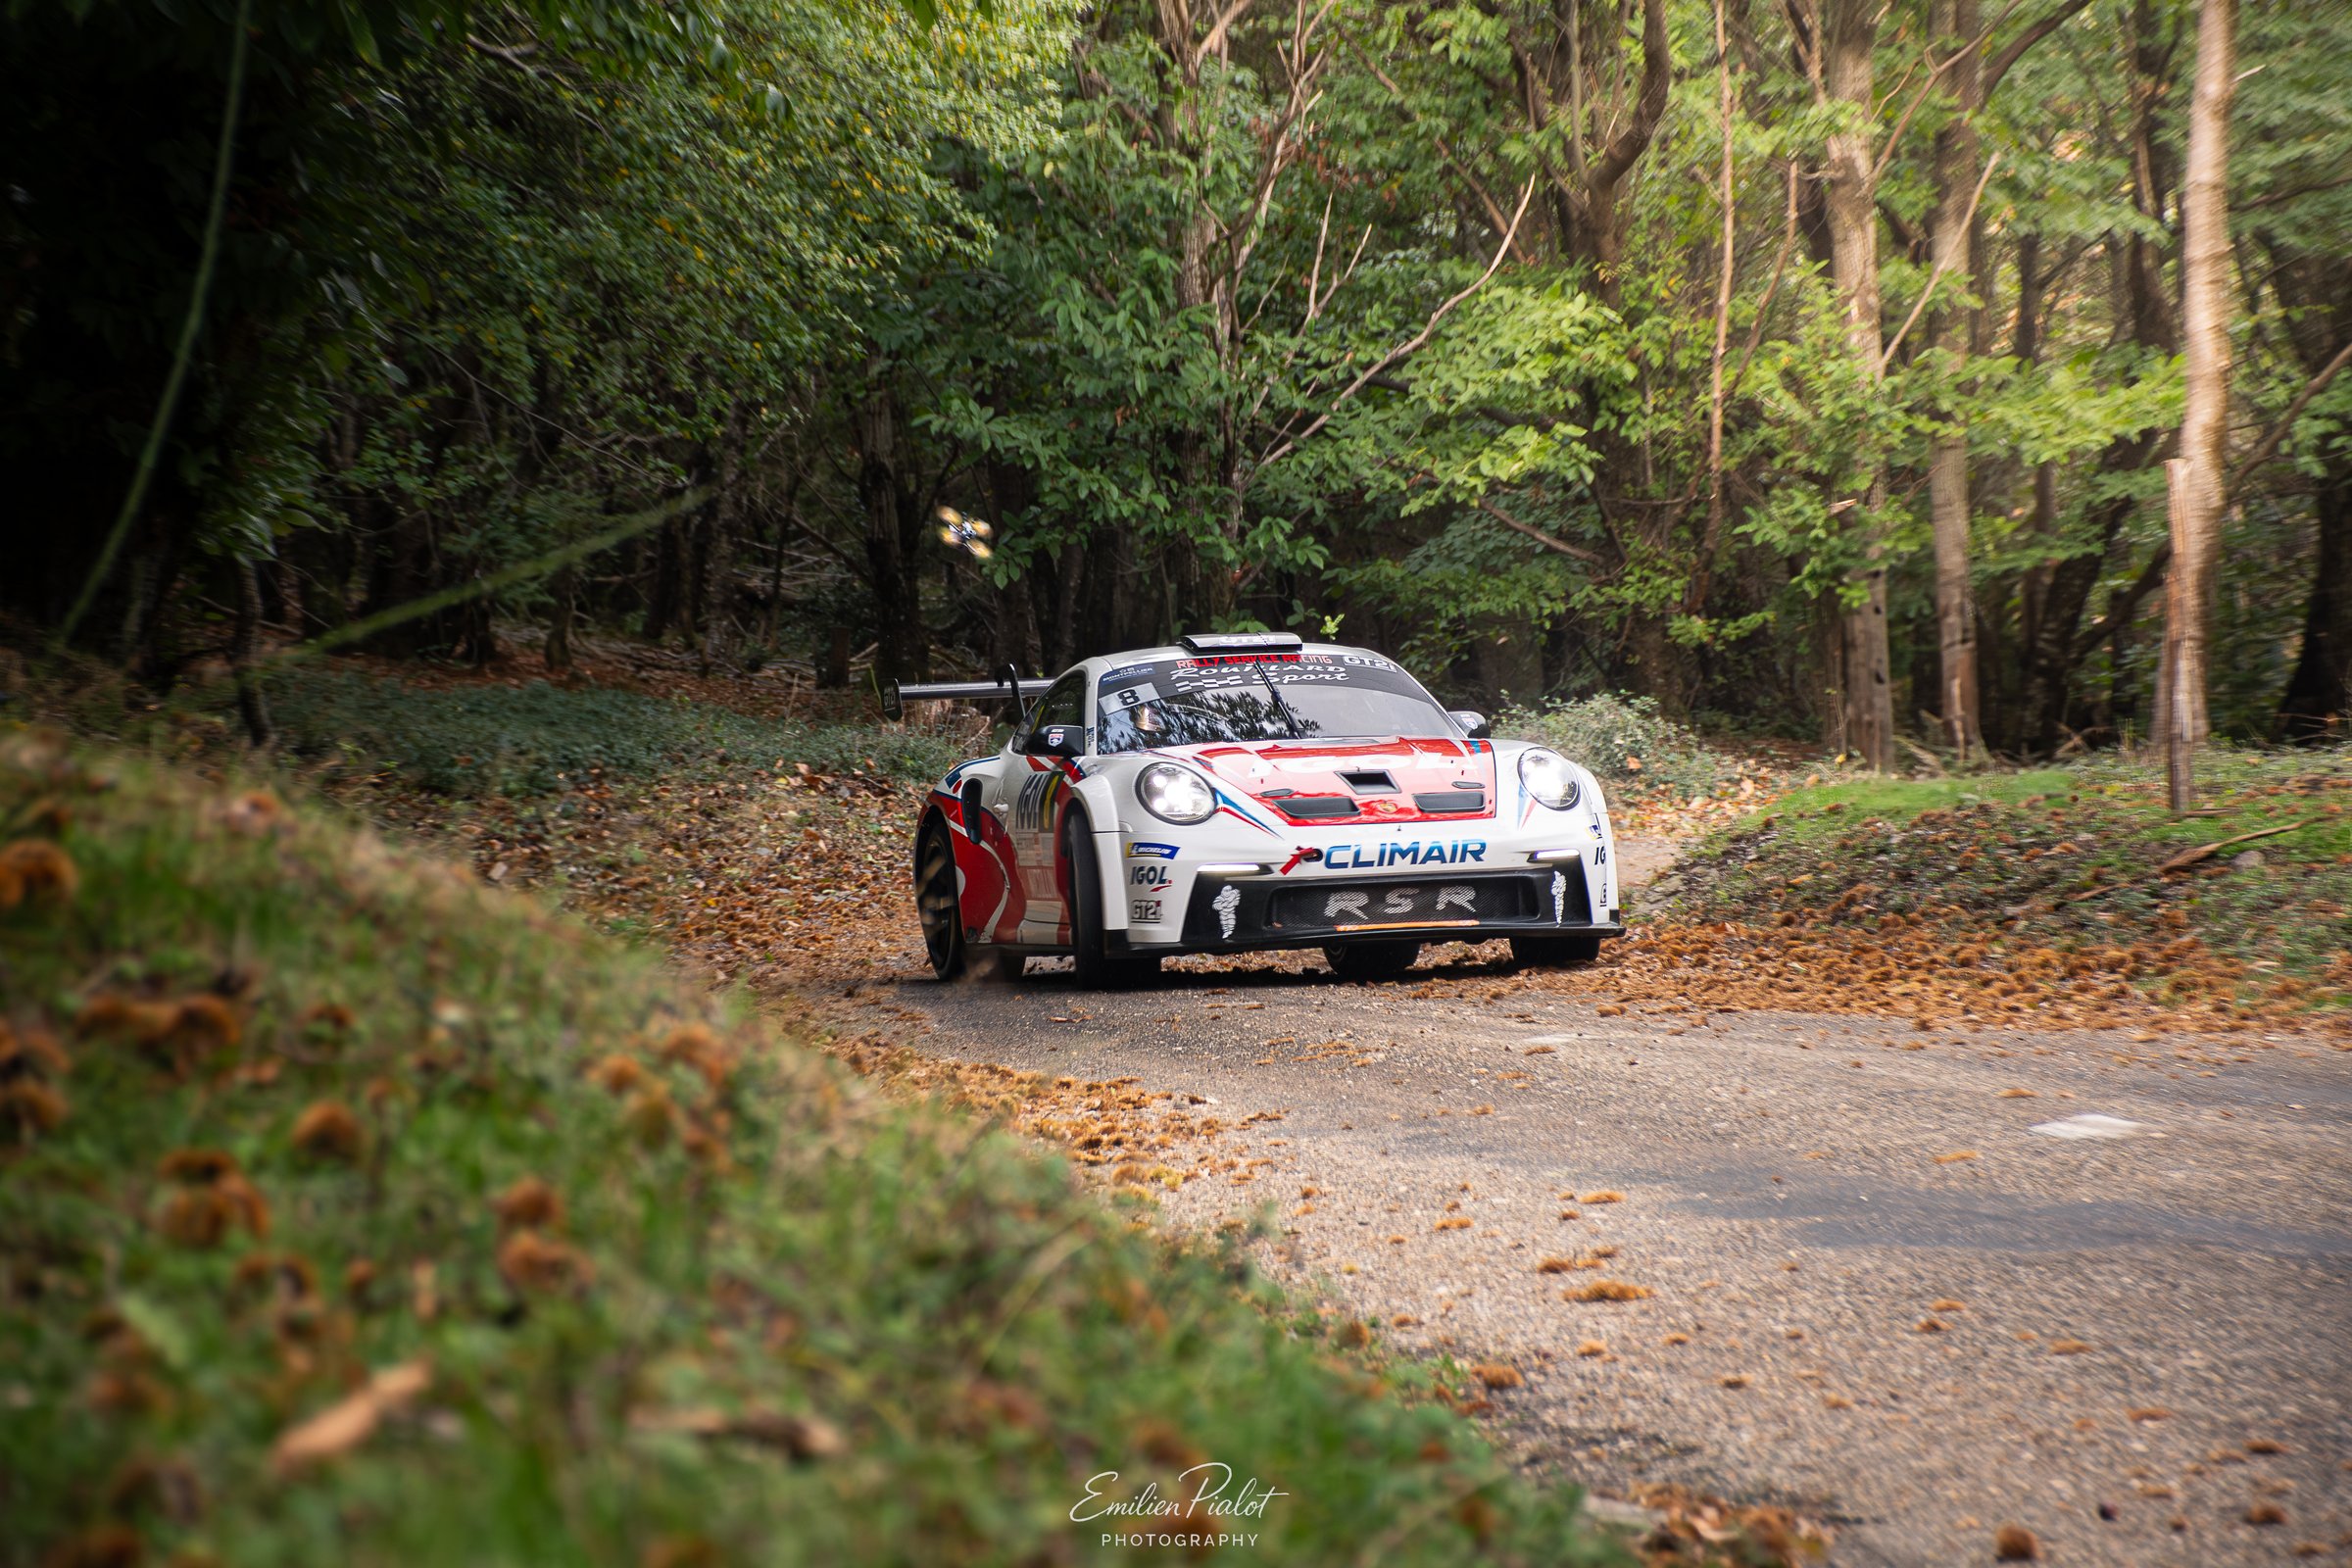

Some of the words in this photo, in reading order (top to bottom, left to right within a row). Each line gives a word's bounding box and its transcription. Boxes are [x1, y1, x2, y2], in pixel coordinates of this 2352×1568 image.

[1176, 658, 1220, 668] RALLY
[1224, 655, 1281, 665] SERVICE
[1282, 654, 1333, 664] RACING
[1251, 672, 1349, 684] Sport
[1117, 689, 1140, 707] 8
[1324, 838, 1487, 870] CLIMAIR
